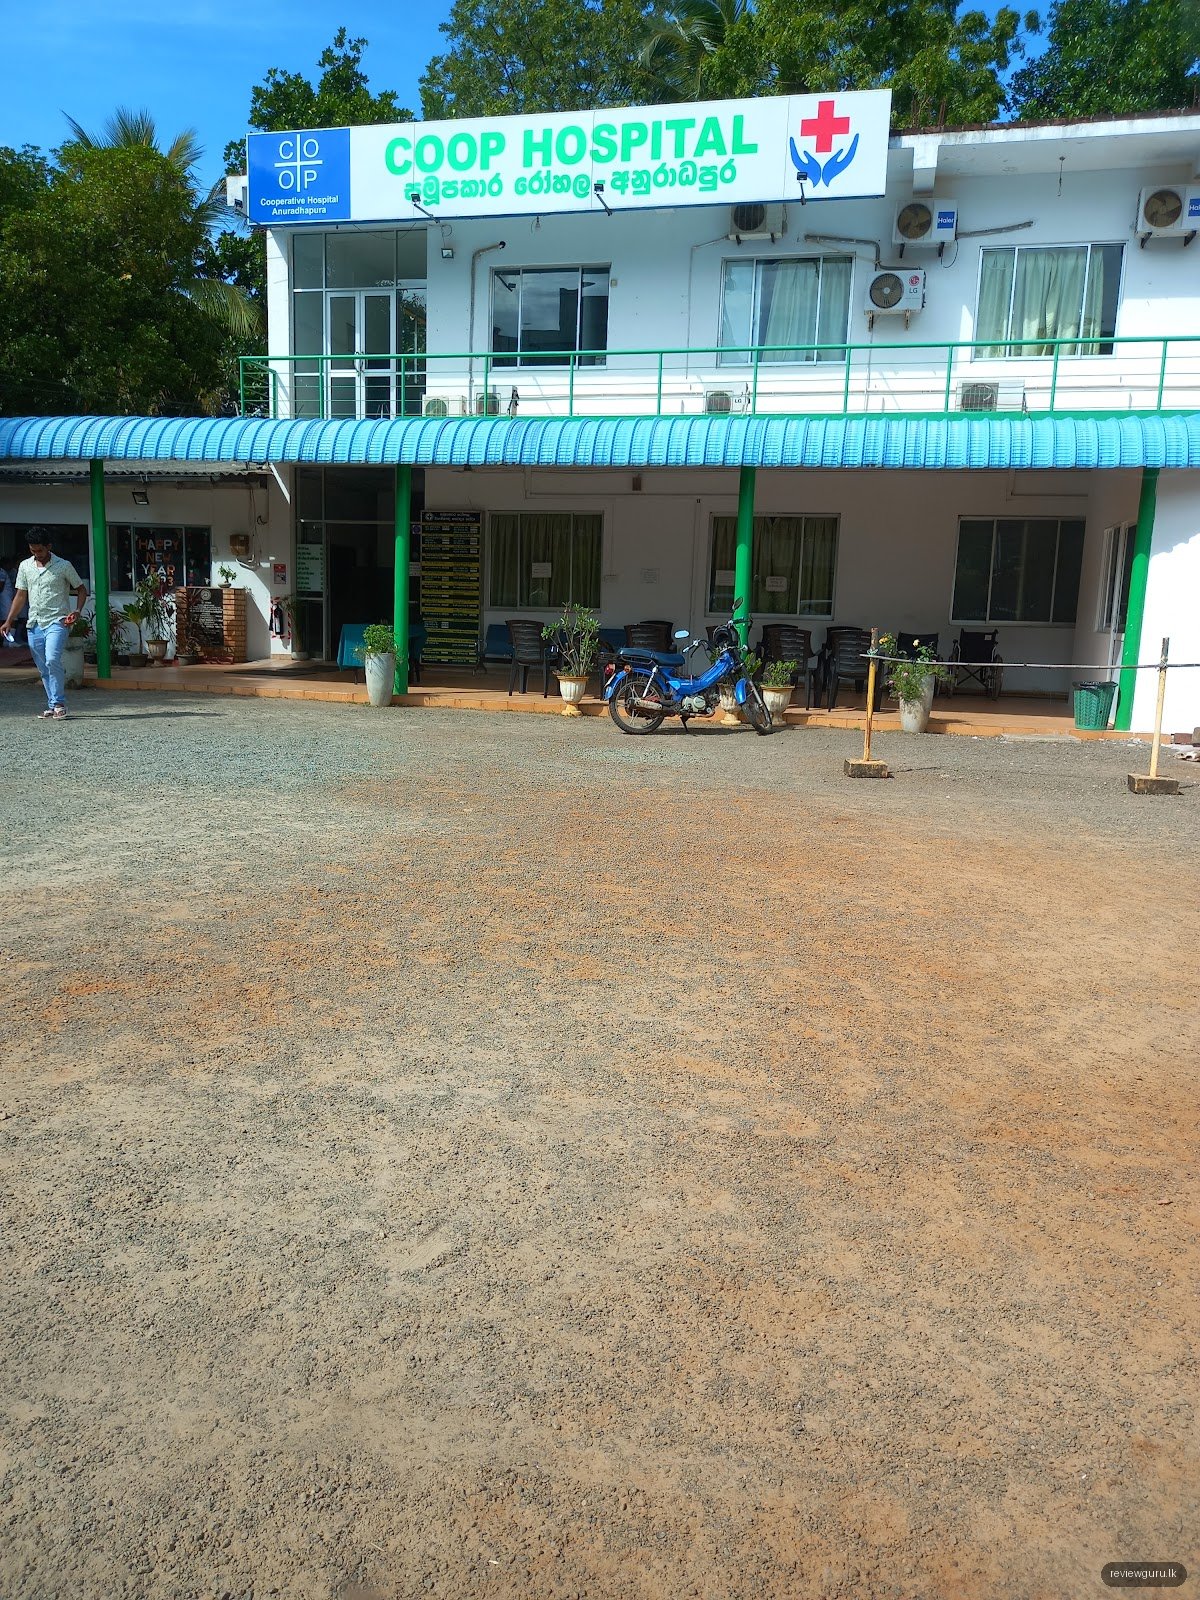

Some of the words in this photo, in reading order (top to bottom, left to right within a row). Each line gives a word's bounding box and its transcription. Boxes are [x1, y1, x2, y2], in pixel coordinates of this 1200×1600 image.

[385, 131, 506, 175] COOP
[522, 114, 759, 168] HOSPITAL
[514, 169, 590, 199] රෝහල
[610, 158, 737, 195] අනුරාධපුර
[260, 196, 306, 207] Cooperative
[307, 195, 339, 206] Hospital
[271, 206, 327, 216] Anuradhapura
[938, 216, 955, 224] Haier
[138, 539, 180, 550] HAPPY
[146, 552, 171, 563] NEW
